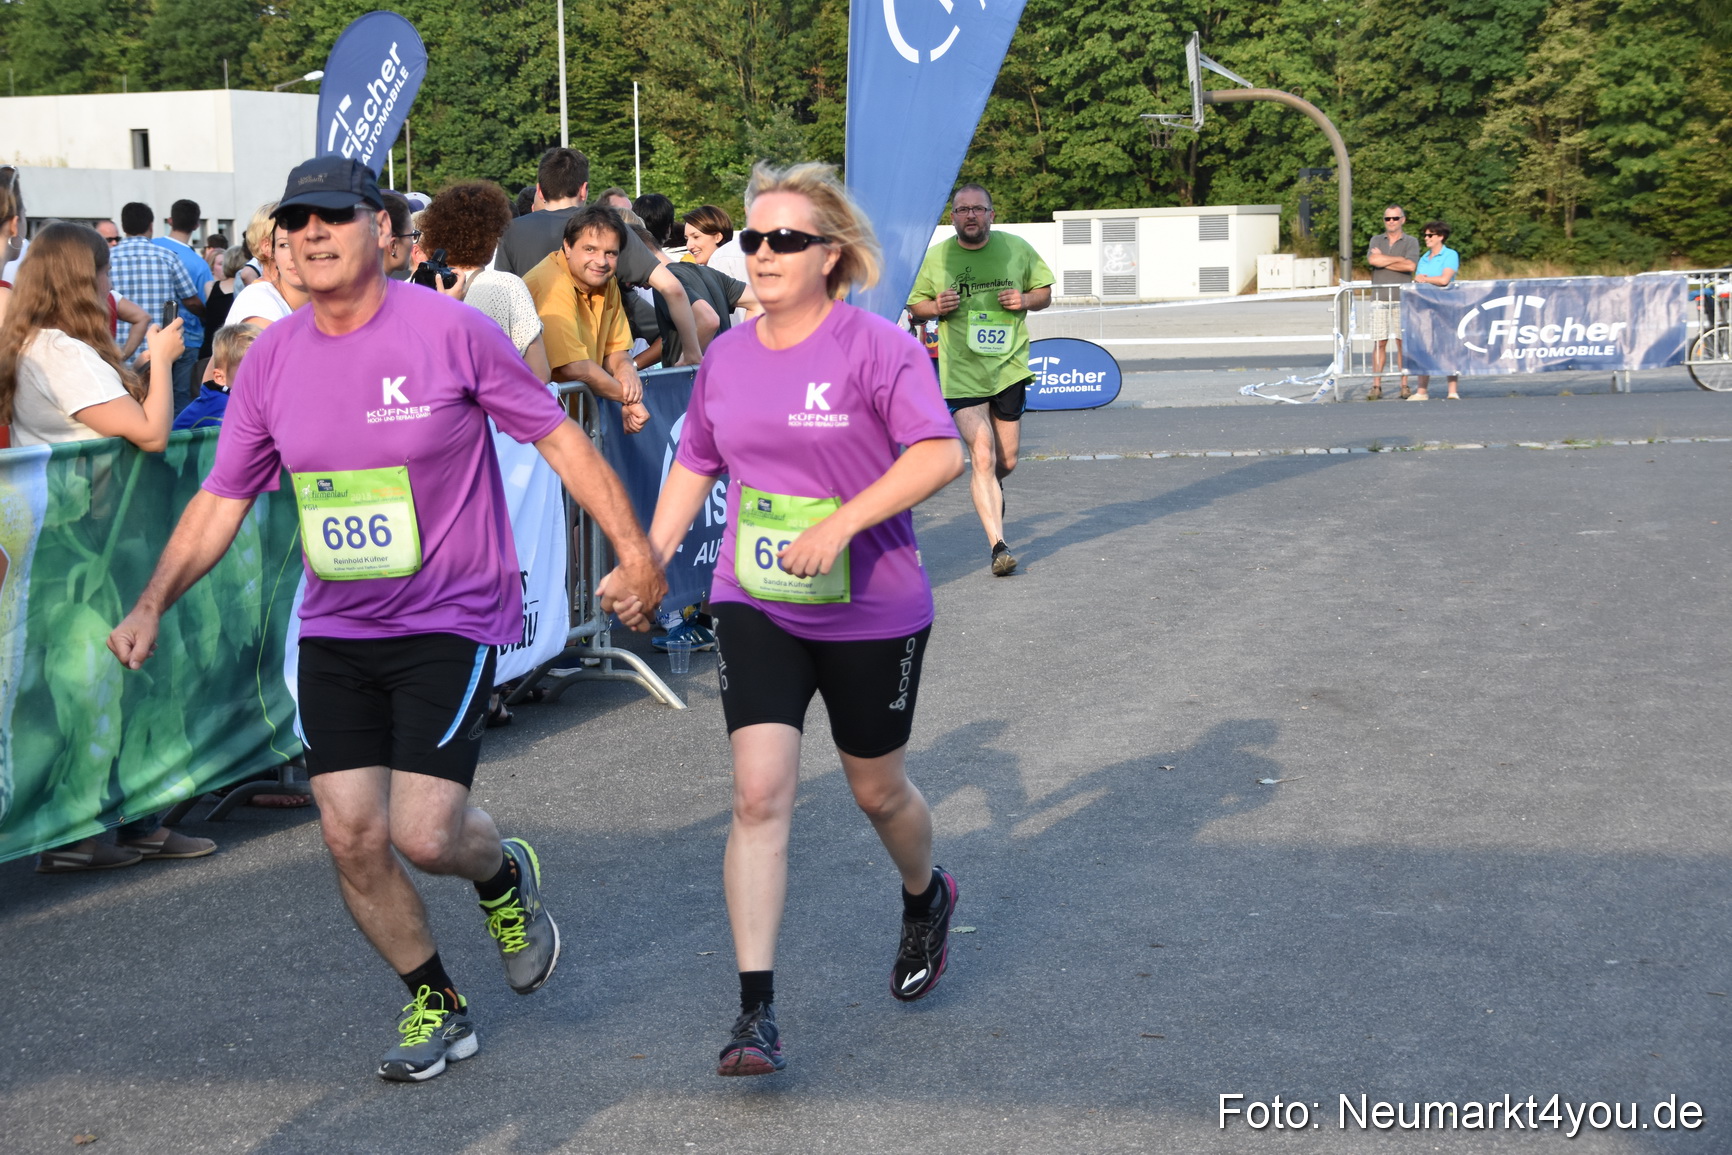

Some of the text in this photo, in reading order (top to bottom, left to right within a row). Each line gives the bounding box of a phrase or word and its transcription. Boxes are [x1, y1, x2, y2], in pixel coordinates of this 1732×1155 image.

[341, 42, 401, 160] Fischer
[361, 66, 410, 167] AUTOMOBILE
[977, 329, 1006, 344] 652
[1487, 317, 1627, 346] Fischer
[1500, 345, 1615, 360] AUTOMOBILE
[383, 376, 410, 405] K
[805, 383, 831, 410] K
[1039, 385, 1102, 395] AUTOMOBILE
[367, 406, 430, 418] KÜFNER
[788, 412, 849, 422] KÜFNER
[322, 513, 393, 551] 686
[333, 555, 388, 566] Reinhold Küfner
[754, 536, 794, 573] 68
[763, 578, 813, 589] Sandra Küfner
